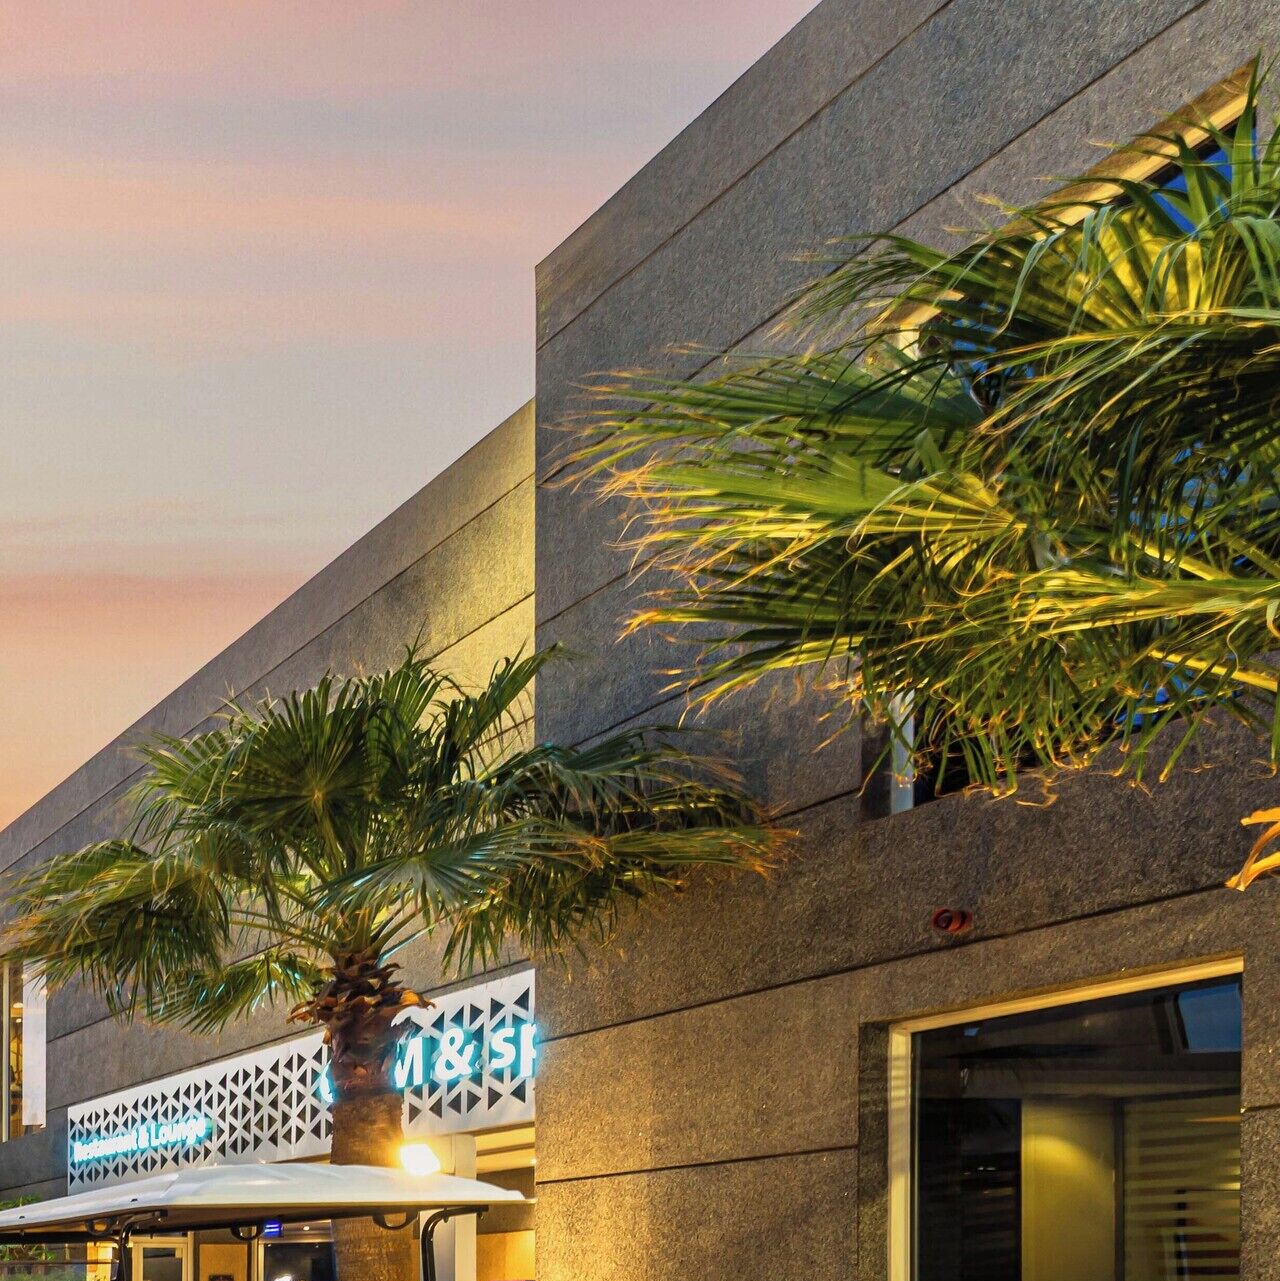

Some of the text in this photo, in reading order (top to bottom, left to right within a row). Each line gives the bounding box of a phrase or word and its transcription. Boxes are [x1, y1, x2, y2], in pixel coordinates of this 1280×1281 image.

[434, 1027, 474, 1081] &
[73, 1117, 207, 1162] Restaurant & Lounge
